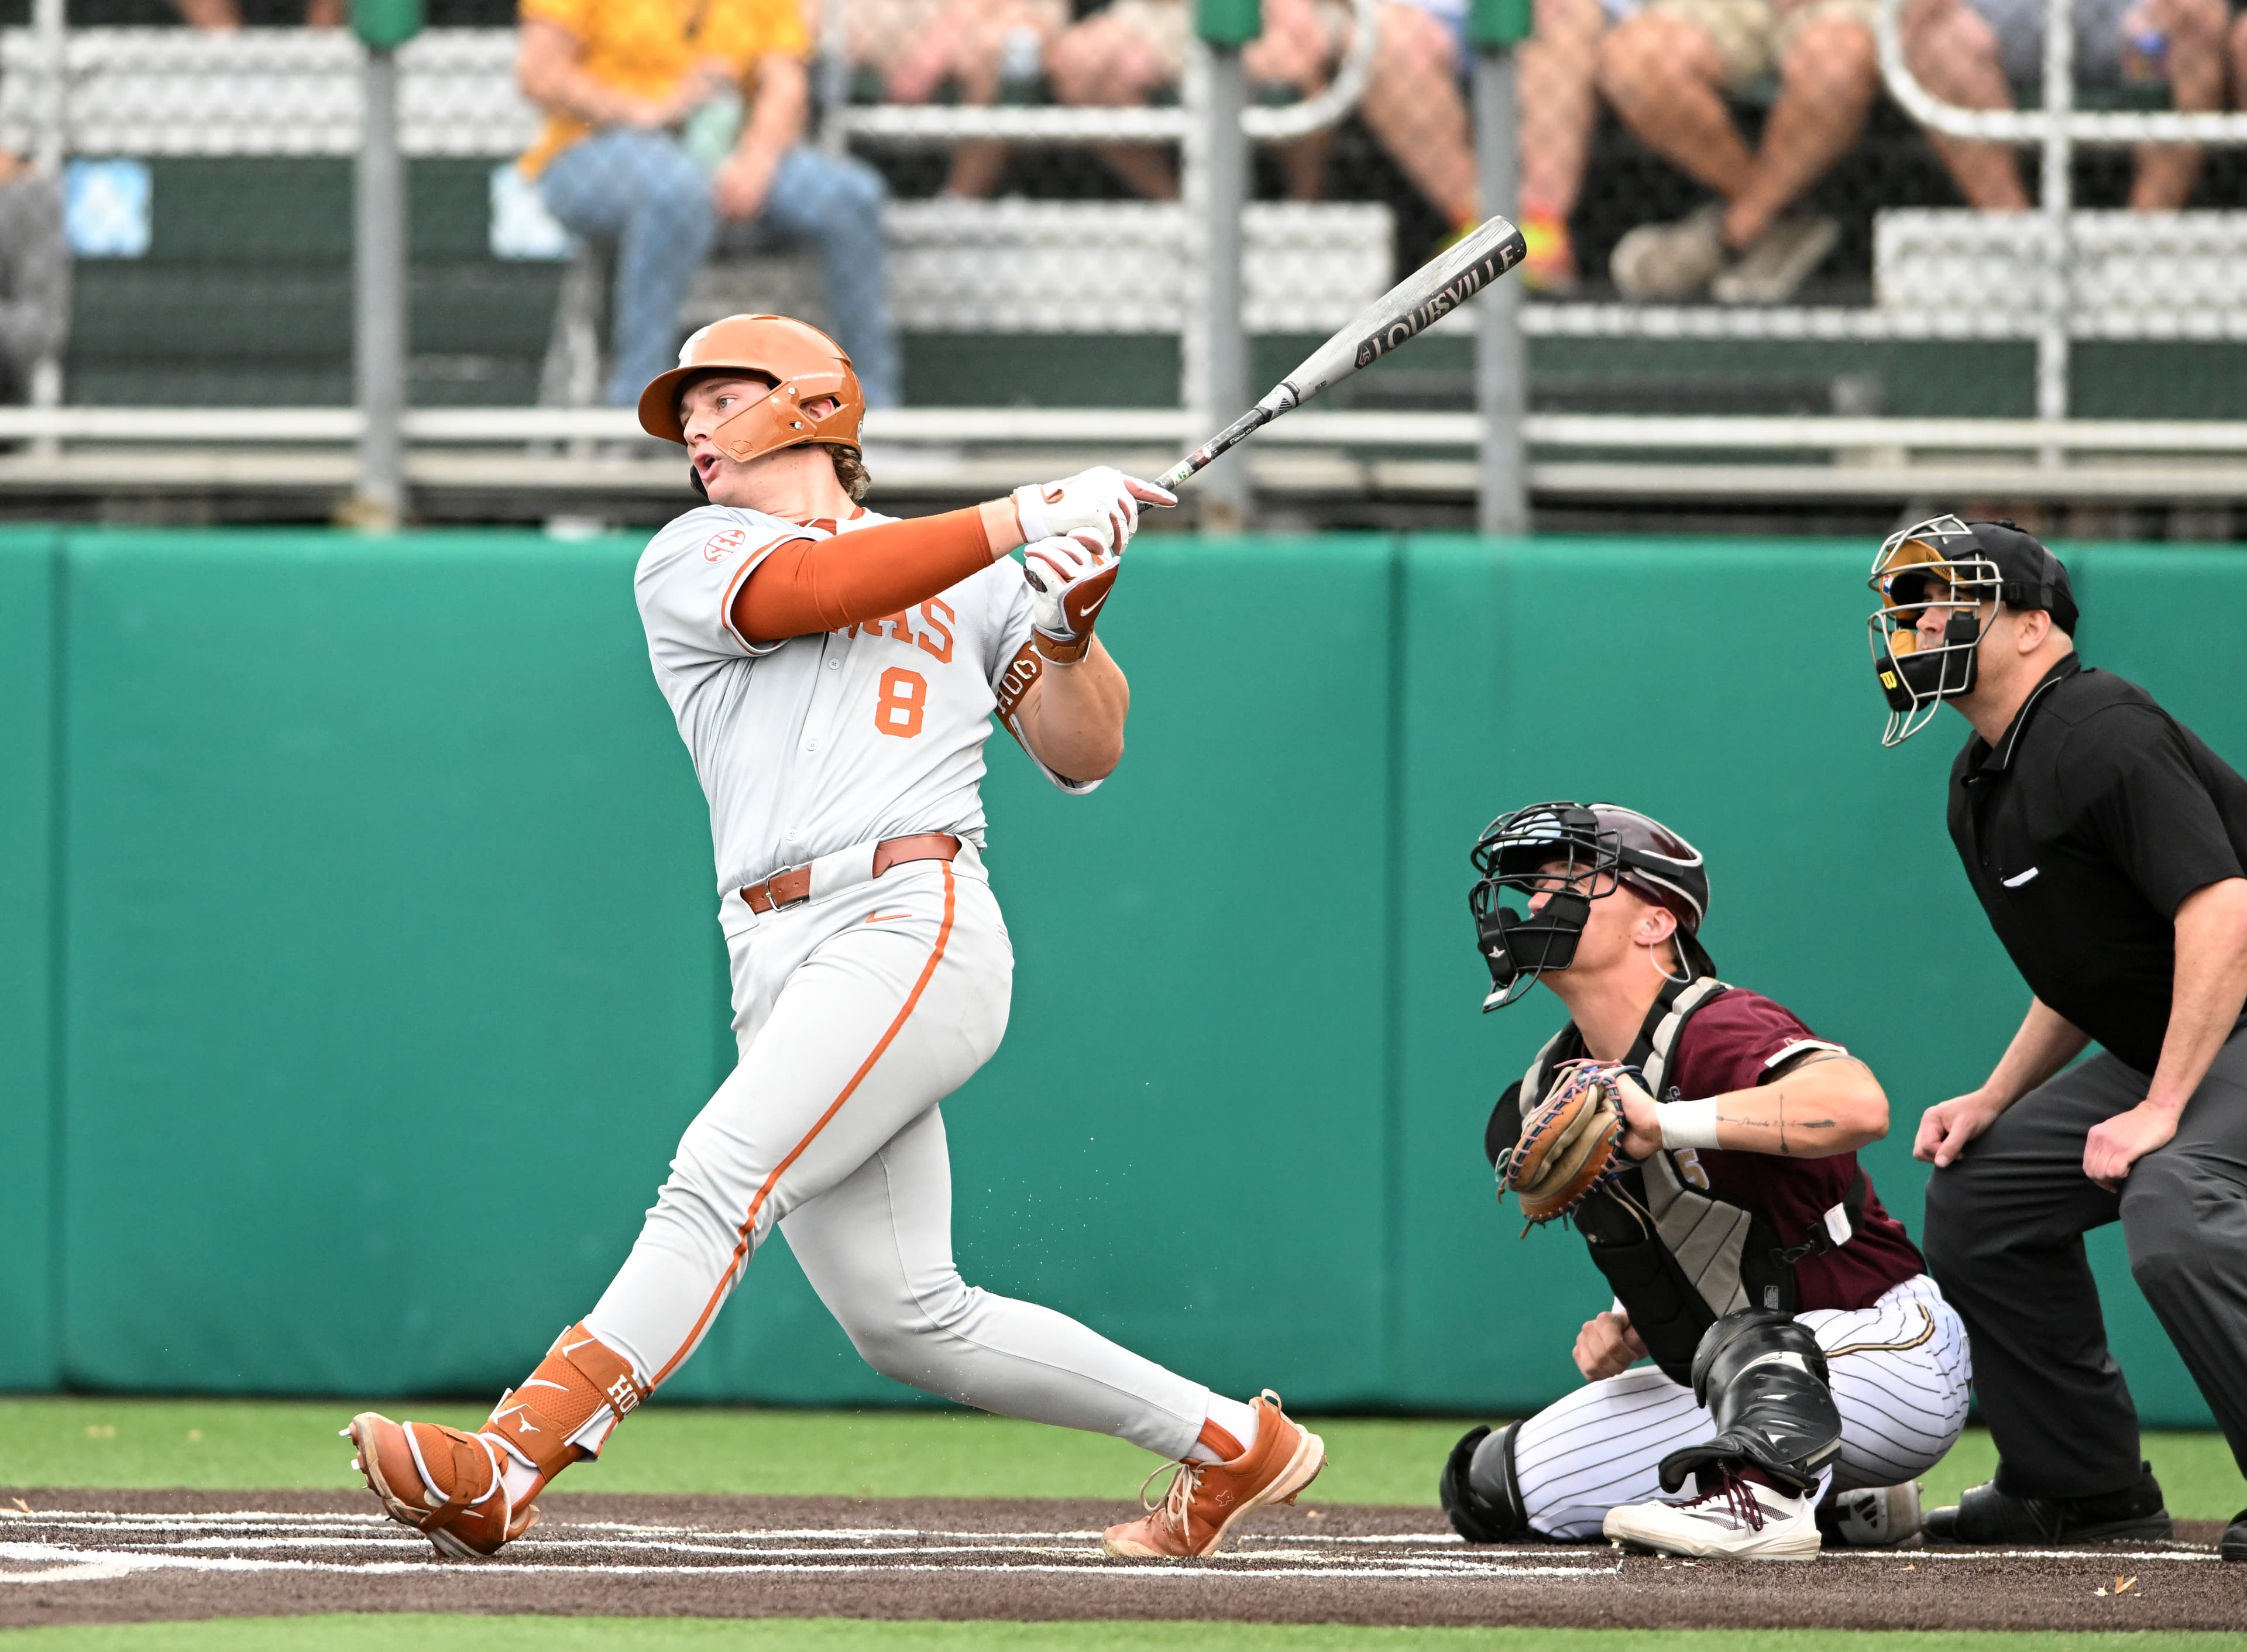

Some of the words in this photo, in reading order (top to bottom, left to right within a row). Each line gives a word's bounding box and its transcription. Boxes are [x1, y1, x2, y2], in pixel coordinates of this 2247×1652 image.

[1372, 244, 1516, 356] LOUISVILLE
[704, 529, 746, 563] SEC
[874, 667, 927, 739] 8
